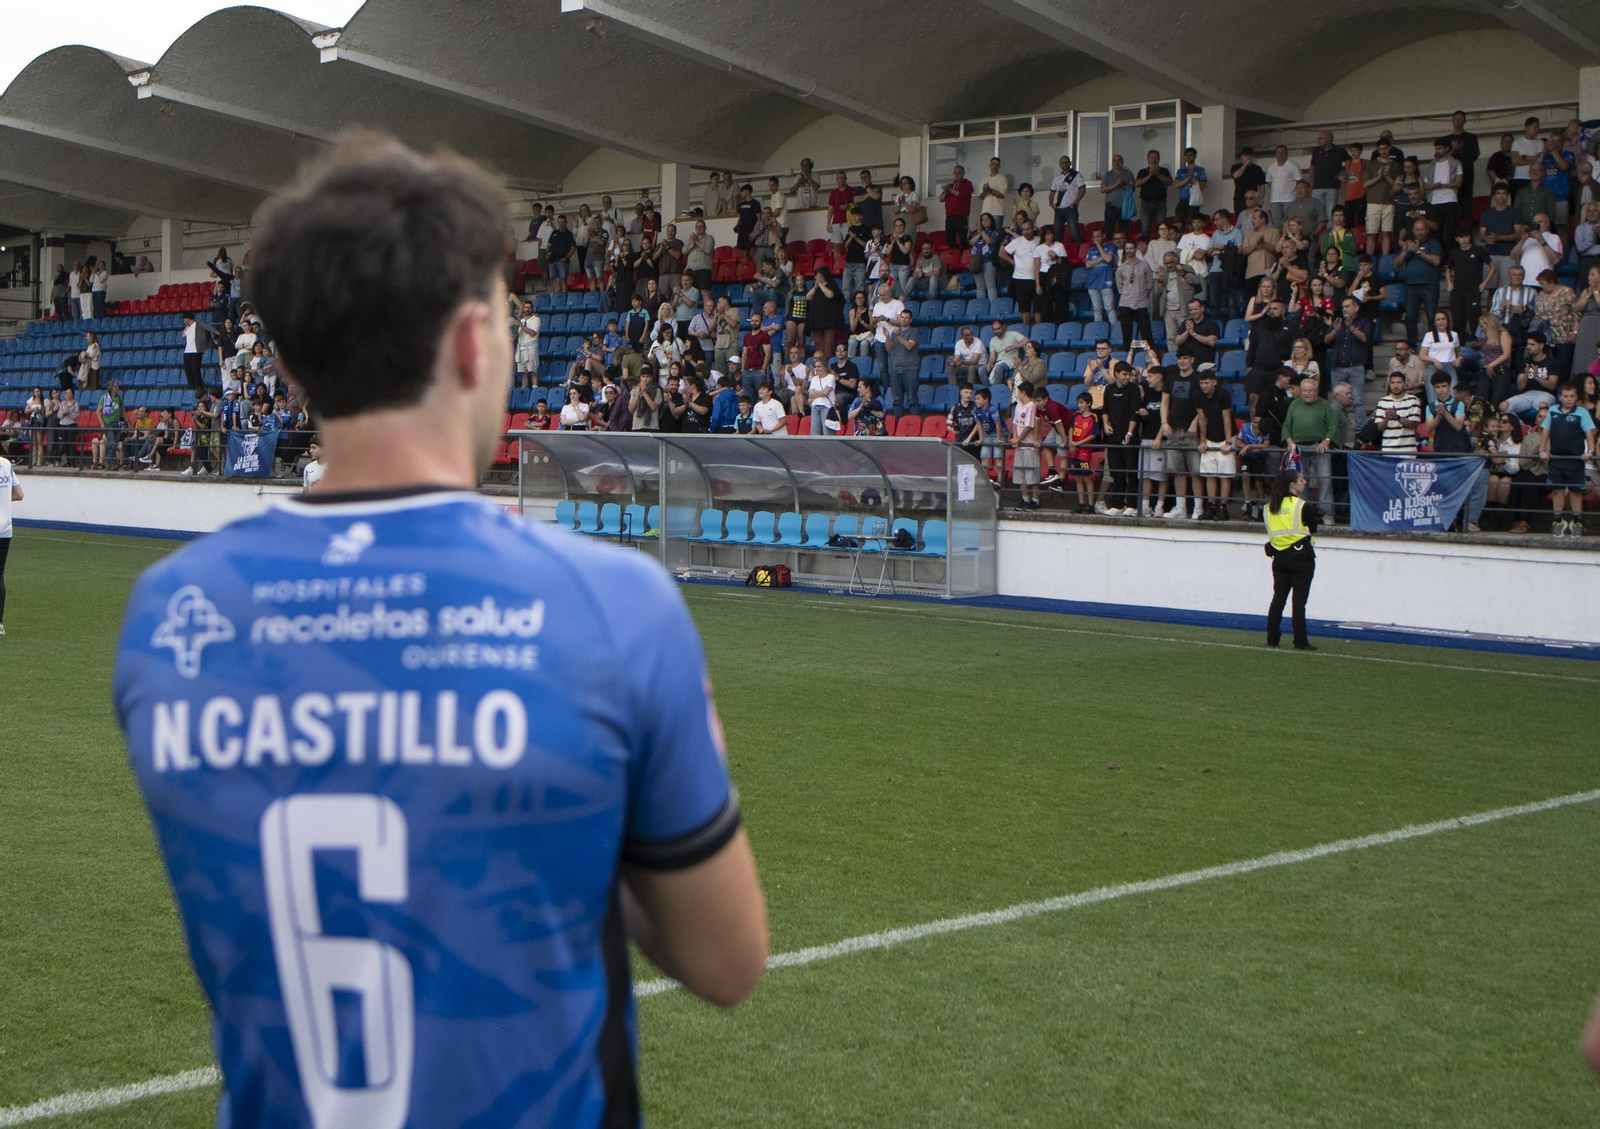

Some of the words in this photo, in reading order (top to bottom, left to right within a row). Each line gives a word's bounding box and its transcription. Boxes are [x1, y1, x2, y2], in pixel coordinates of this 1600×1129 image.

[1382, 510, 1402, 524] QUE
[1404, 507, 1425, 520] NOS
[1389, 498, 1402, 510] LA
[1404, 492, 1443, 508] ILUSIÓN
[252, 572, 427, 603] HOSPITALES
[250, 601, 430, 645] recoletas
[437, 595, 545, 639] salud
[400, 642, 540, 671] OURENSE
[153, 690, 528, 771] N.CASTILLO
[261, 794, 413, 1129] 6
